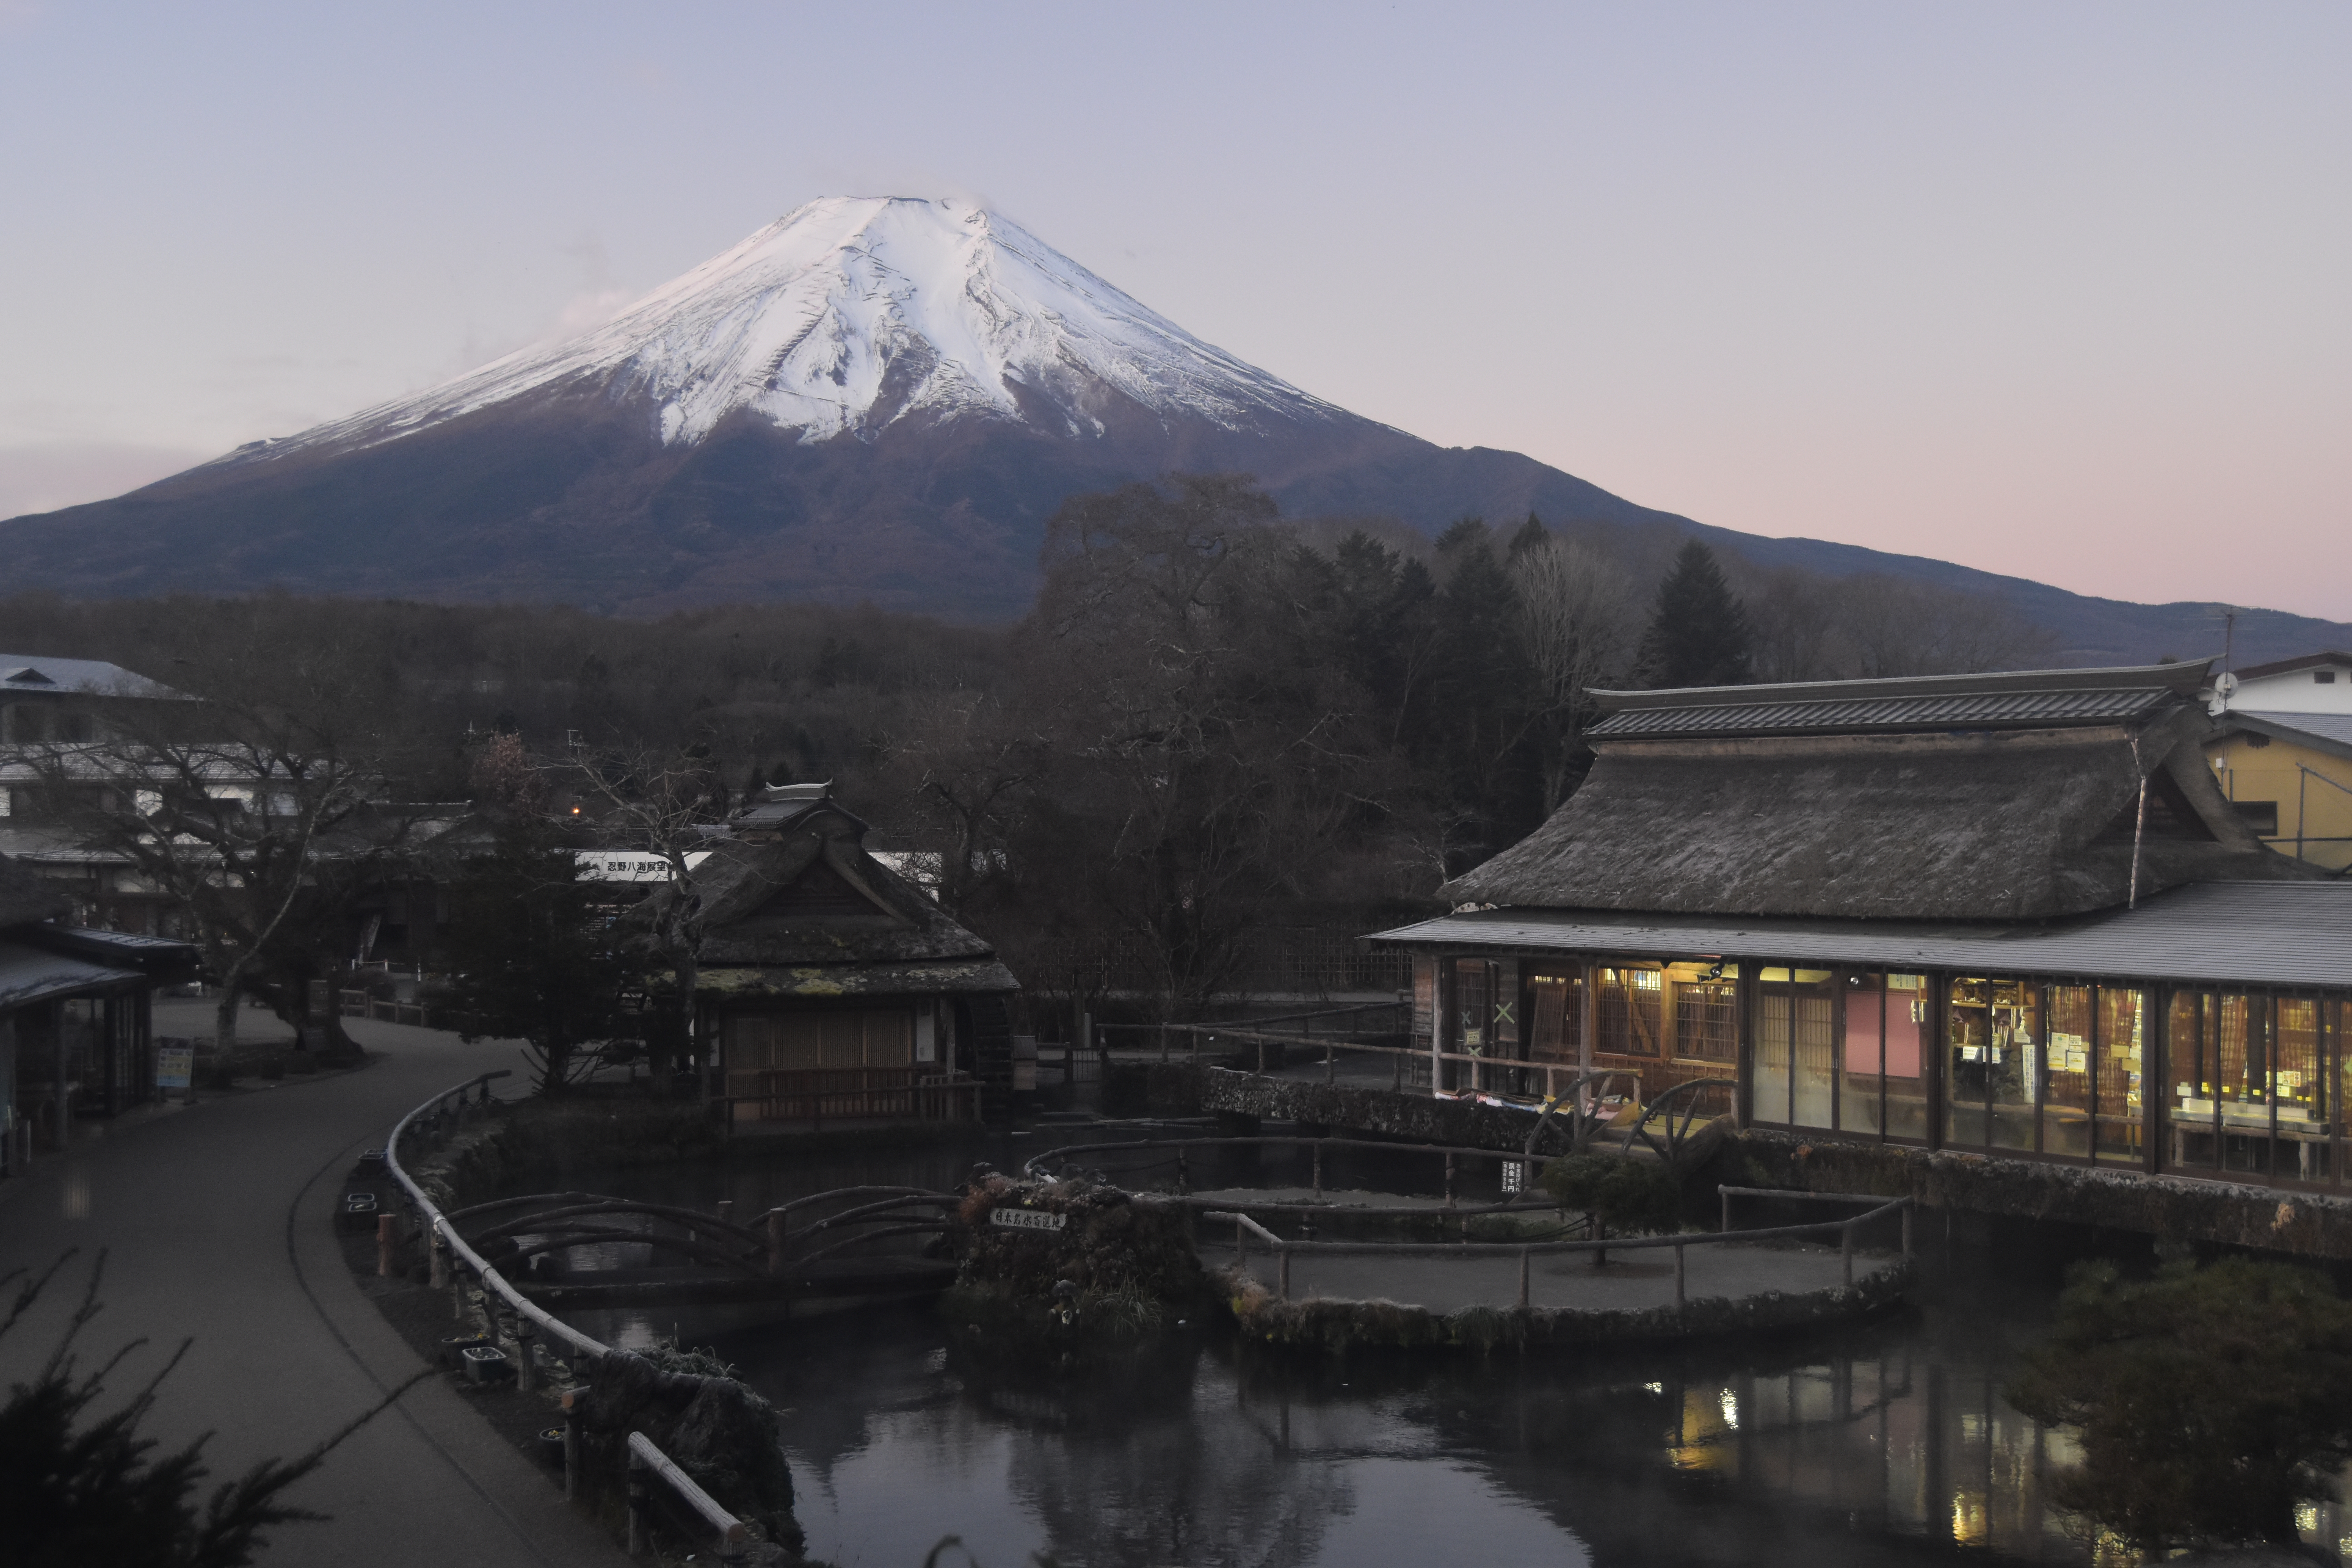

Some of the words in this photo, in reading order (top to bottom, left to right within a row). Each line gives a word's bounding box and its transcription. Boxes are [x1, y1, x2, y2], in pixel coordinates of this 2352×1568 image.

[608, 862, 671, 871] 忍野八海展望
